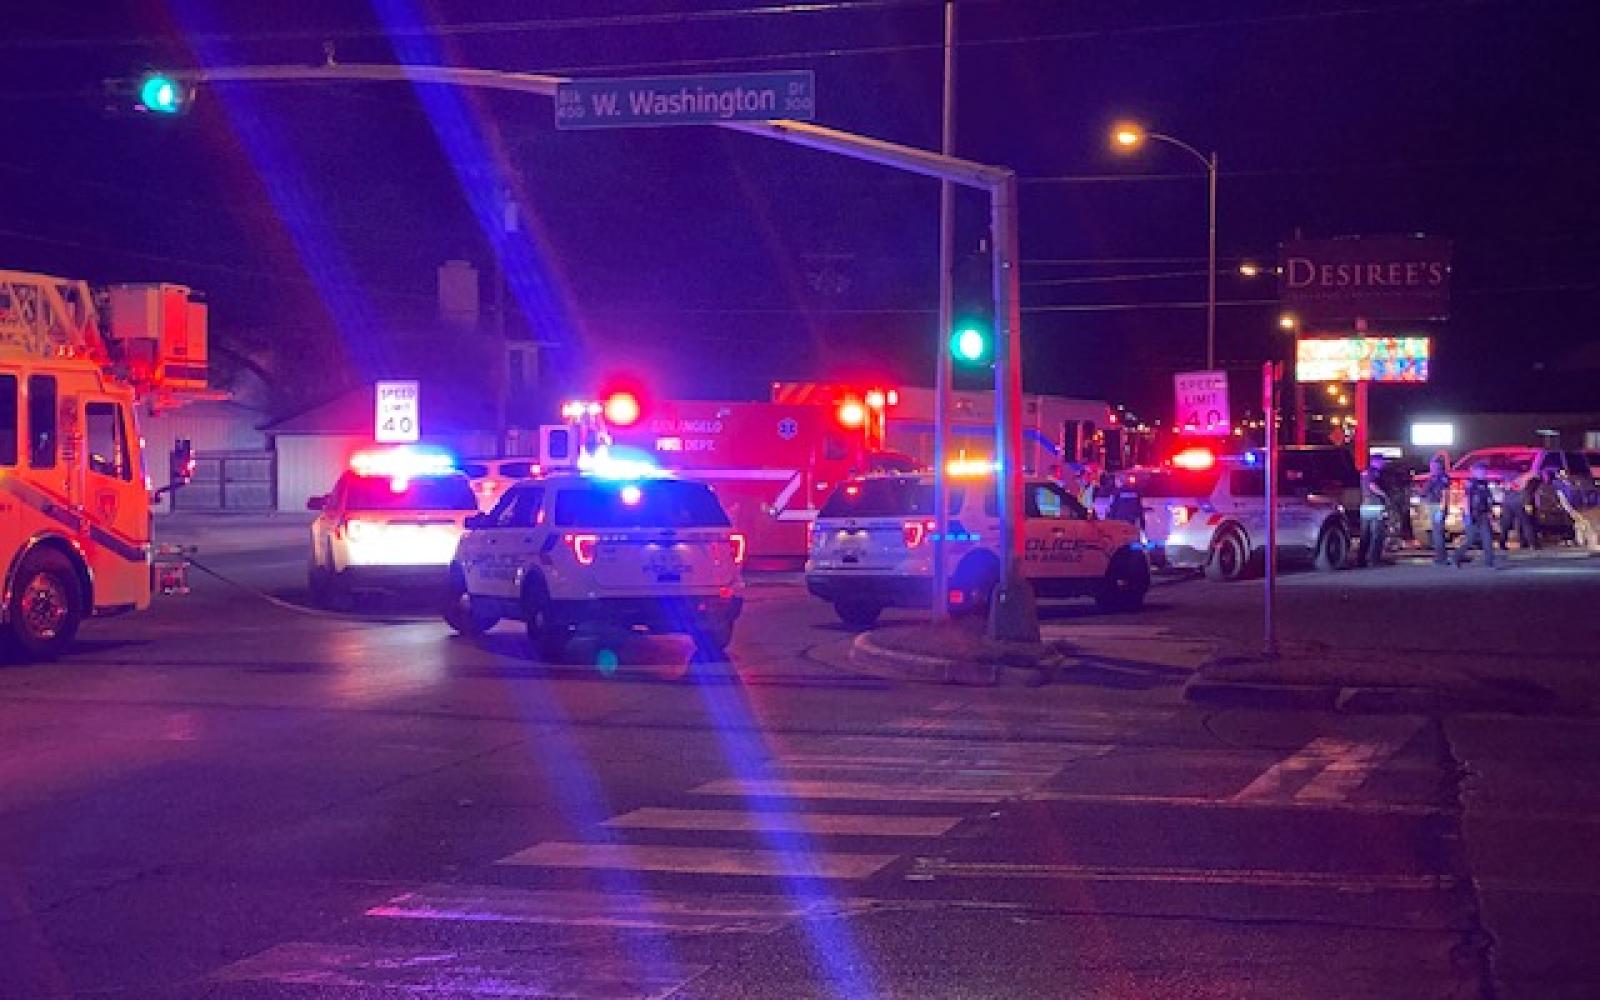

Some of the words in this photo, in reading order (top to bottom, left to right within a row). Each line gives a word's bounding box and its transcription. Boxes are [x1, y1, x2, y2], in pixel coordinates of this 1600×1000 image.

[788, 82, 806, 95] Dr
[591, 90, 621, 116] W.
[629, 84, 776, 117] Washington
[1286, 257, 1443, 288] DESIREE'S
[1184, 393, 1216, 407] LIMIT
[382, 416, 413, 433] 40
[1185, 409, 1221, 427] 40
[1025, 537, 1084, 551] OLICE
